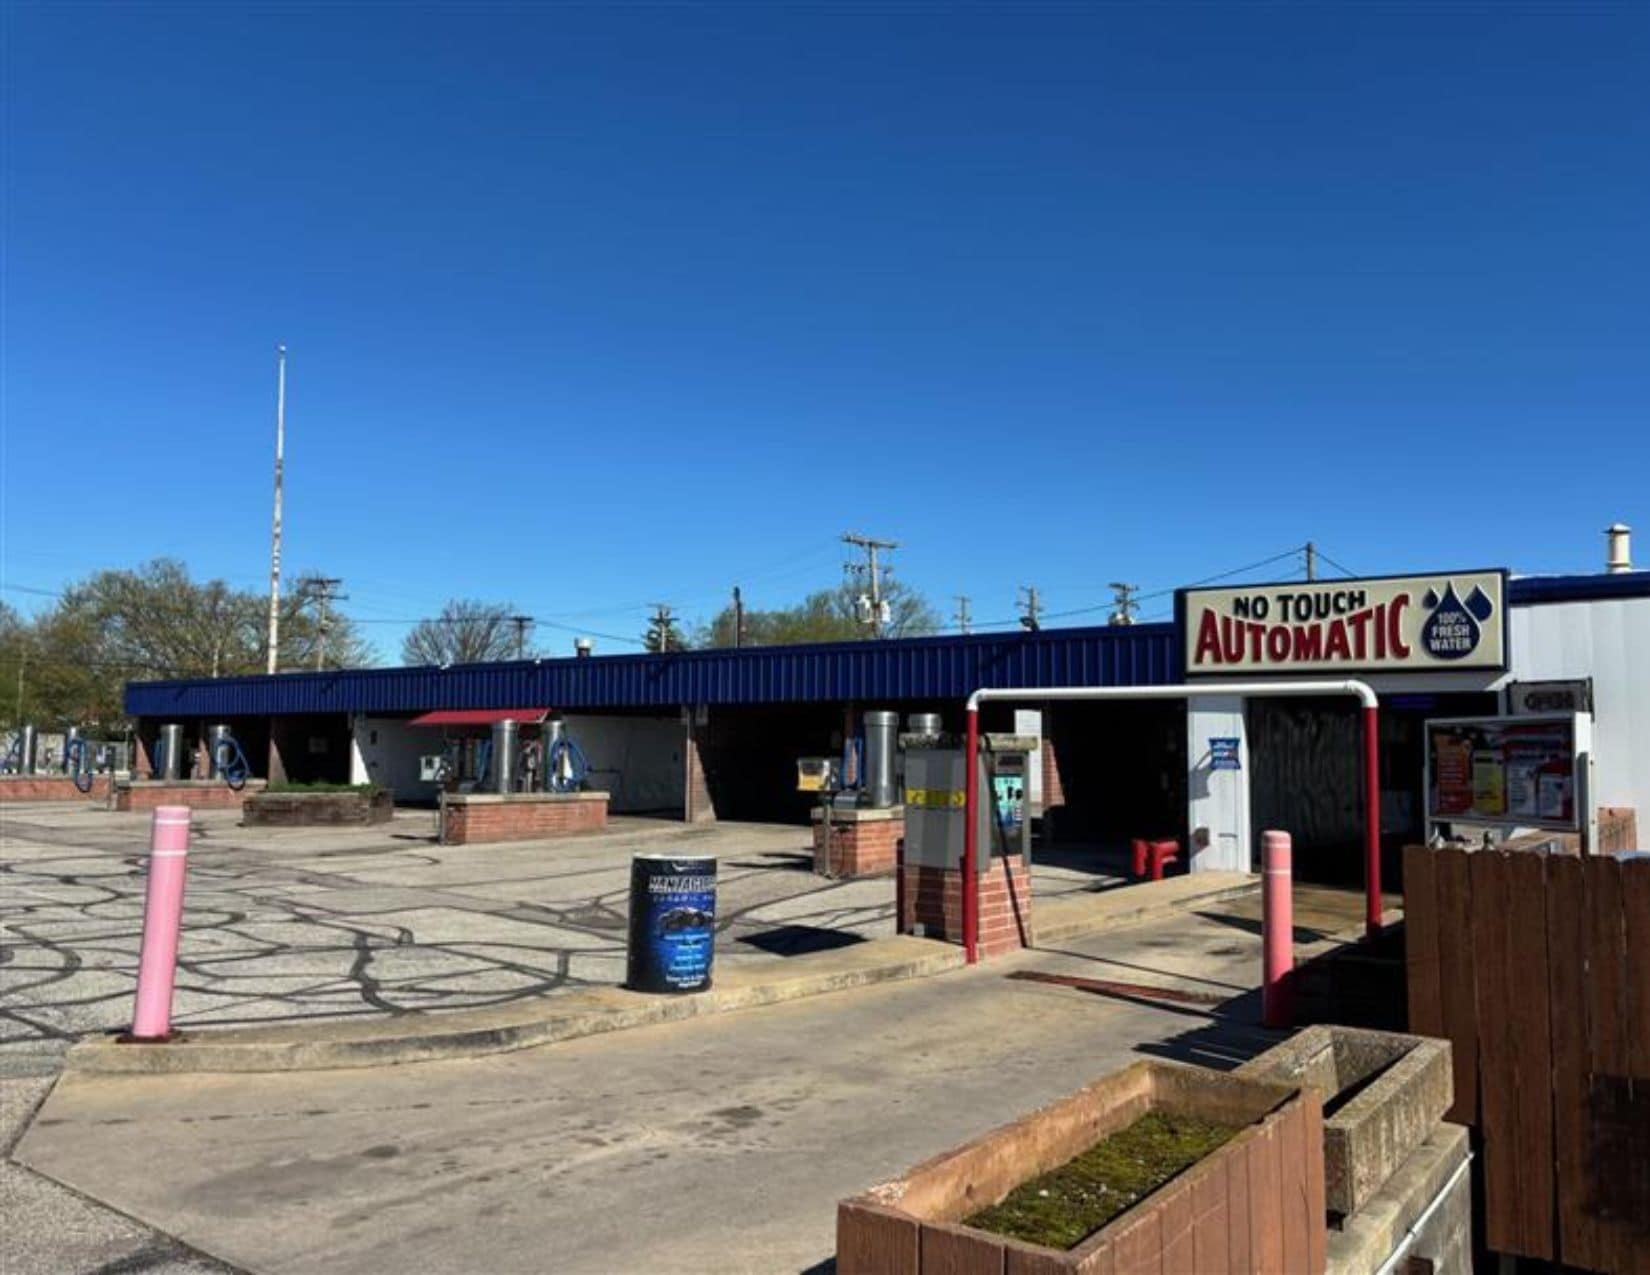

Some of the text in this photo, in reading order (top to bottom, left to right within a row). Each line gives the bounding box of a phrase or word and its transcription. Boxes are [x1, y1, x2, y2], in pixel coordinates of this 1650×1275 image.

[1233, 591, 1366, 622] NO TOUCH
[1194, 594, 1411, 664] AUTOMATIC
[1431, 624, 1470, 637] FRESH
[1430, 637, 1472, 651] WATER
